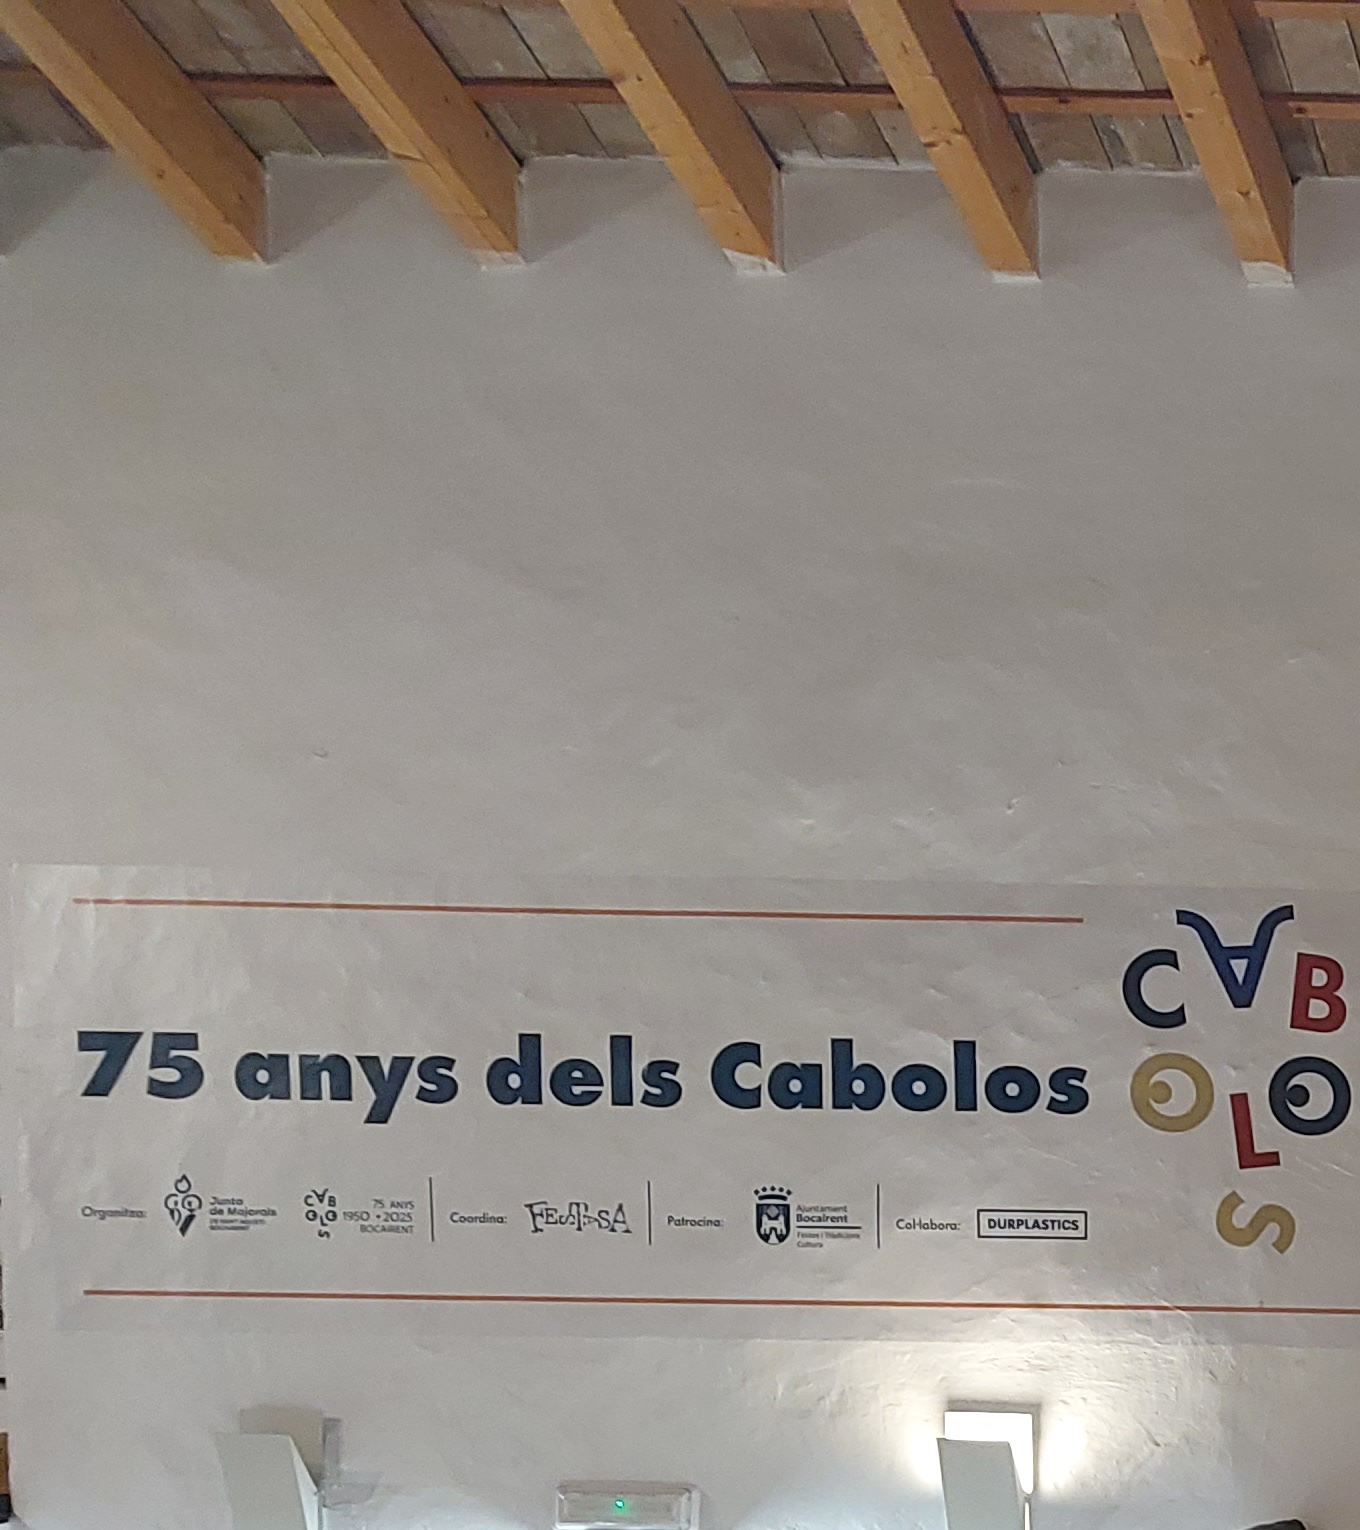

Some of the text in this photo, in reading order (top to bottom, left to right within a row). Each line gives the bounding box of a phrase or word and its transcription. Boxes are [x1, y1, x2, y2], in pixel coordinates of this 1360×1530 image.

[76, 1030, 1090, 1124] 75 anys dels Cabolos
[390, 1200, 415, 1210] ANYS
[796, 1204, 847, 1214] Ajuntament
[209, 1207, 277, 1218] de Majorals
[343, 1211, 413, 1222] 1950 2025
[450, 1211, 508, 1224] Coordina:
[796, 1213, 848, 1223] Bocairent
[667, 1215, 724, 1228] Patrocina:
[987, 1218, 1080, 1231] DURPLASTICS
